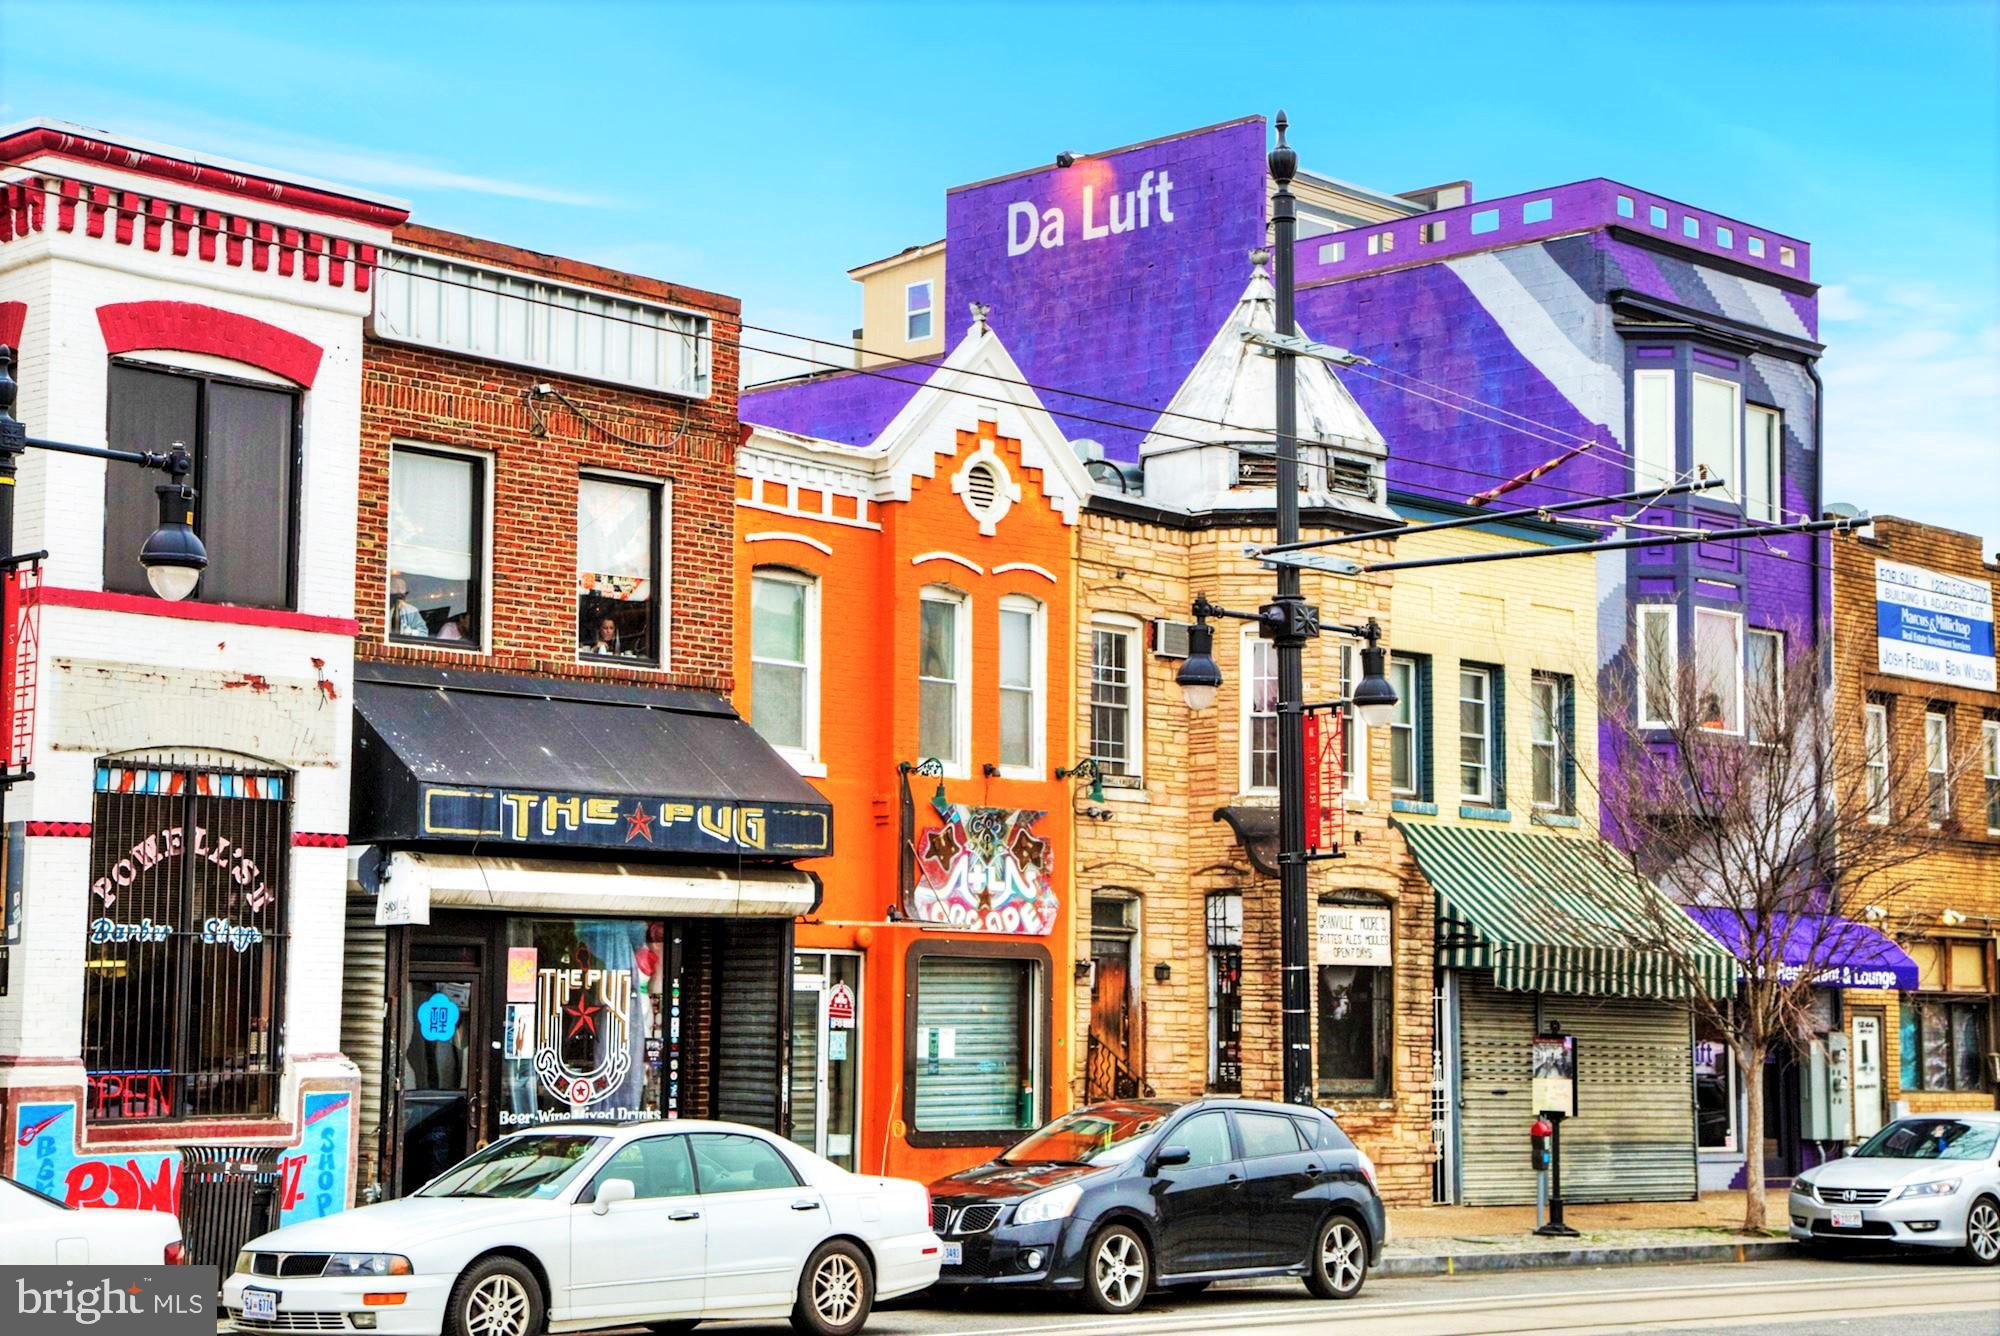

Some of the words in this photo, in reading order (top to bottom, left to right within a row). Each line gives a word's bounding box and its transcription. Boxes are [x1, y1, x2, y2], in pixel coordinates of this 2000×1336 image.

[1007, 200, 1065, 257] Da
[1082, 170, 1174, 240] Luft
[1880, 568, 1896, 579] FOR
[1900, 572, 1918, 586] SALE
[1885, 587, 1919, 605] BUILDING
[1931, 597, 1968, 614] ADJACENT
[1971, 605, 1984, 618] LOT
[1902, 607, 1929, 626] Marcus
[1930, 618, 1938, 633] &
[1936, 615, 1970, 639] Millichap
[1883, 648, 1903, 667] JOSH
[1906, 652, 1941, 674] FELDMAN
[1946, 659, 1960, 677] BEN
[1963, 663, 1993, 683] WILSON
[503, 794, 619, 841] THE
[660, 803, 766, 850] PUG
[92, 826, 260, 909] POWELL'S
[90, 917, 174, 945] Barber
[201, 917, 263, 953] Shop
[1319, 915, 1353, 930] GRANVILLE
[1843, 966, 1852, 984] &
[1855, 970, 1896, 988] Lounge
[87, 1074, 174, 1117] PEN
[499, 1109, 535, 1125] Beer
[617, 1106, 662, 1120] Drinks
[318, 1127, 335, 1217] SHOP
